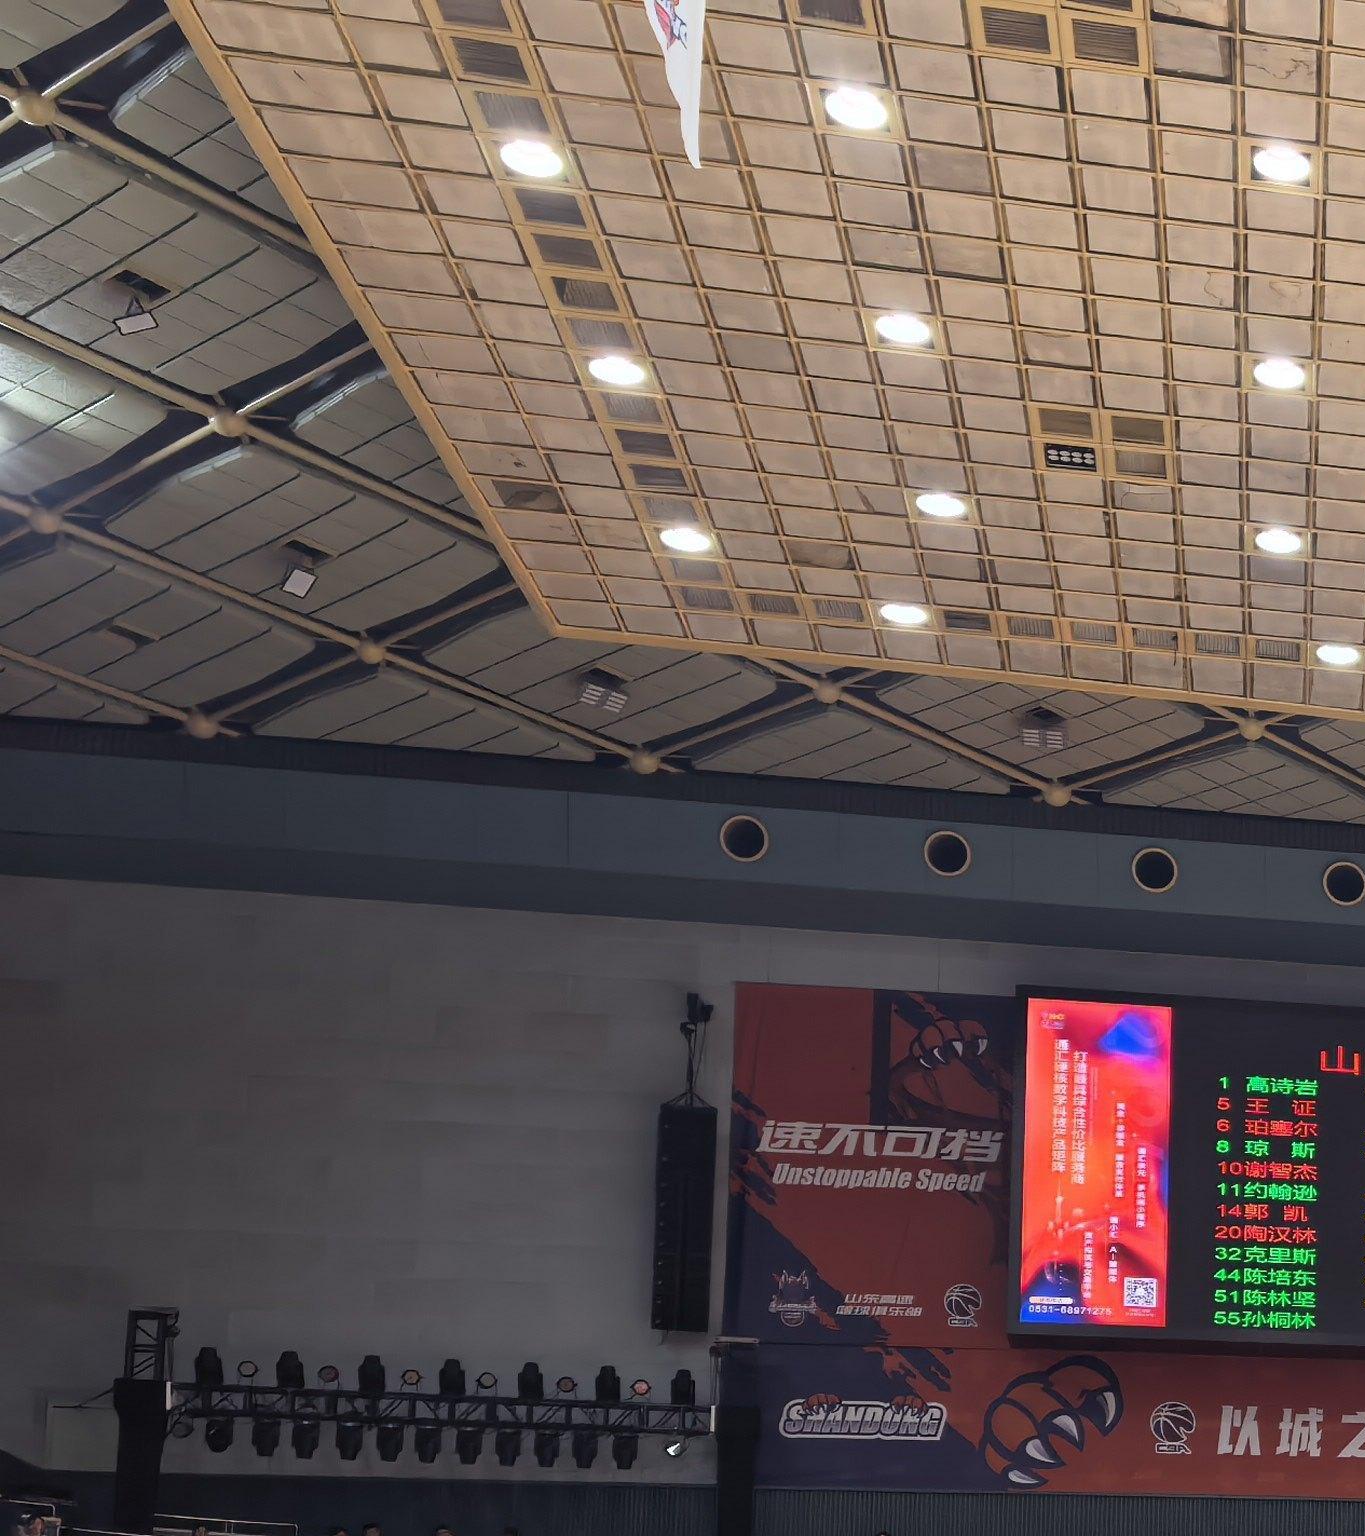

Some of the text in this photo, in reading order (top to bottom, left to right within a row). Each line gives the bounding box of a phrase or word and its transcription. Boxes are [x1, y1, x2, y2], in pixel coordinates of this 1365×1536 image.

[1219, 1077, 1228, 1089] 1
[1246, 1075, 1319, 1097] 高诗岩
[1217, 1098, 1230, 1111] 5
[1216, 1119, 1230, 1132] 6
[756, 1120, 1003, 1162] 速不可挡
[1216, 1140, 1230, 1153] 8
[773, 1163, 986, 1193] Unstoppable Speed
[1218, 1161, 1242, 1175] 10
[1244, 1160, 1318, 1181] 谢智杰
[1217, 1183, 1239, 1196] 11
[1244, 1182, 1318, 1201] 约翰逊
[1217, 1204, 1241, 1217] 14
[1214, 1225, 1241, 1239] 20
[1244, 1225, 1317, 1244] 陶汉林
[1214, 1247, 1241, 1261] 32
[1244, 1246, 1317, 1266] 克里斯
[1214, 1268, 1241, 1281] 44
[1214, 1290, 1238, 1303] 51
[1243, 1289, 1316, 1308] 陈林坚
[1214, 1311, 1241, 1325] 55
[1242, 1310, 1316, 1329] 孙桐林
[783, 1403, 942, 1437] SHANDONG
